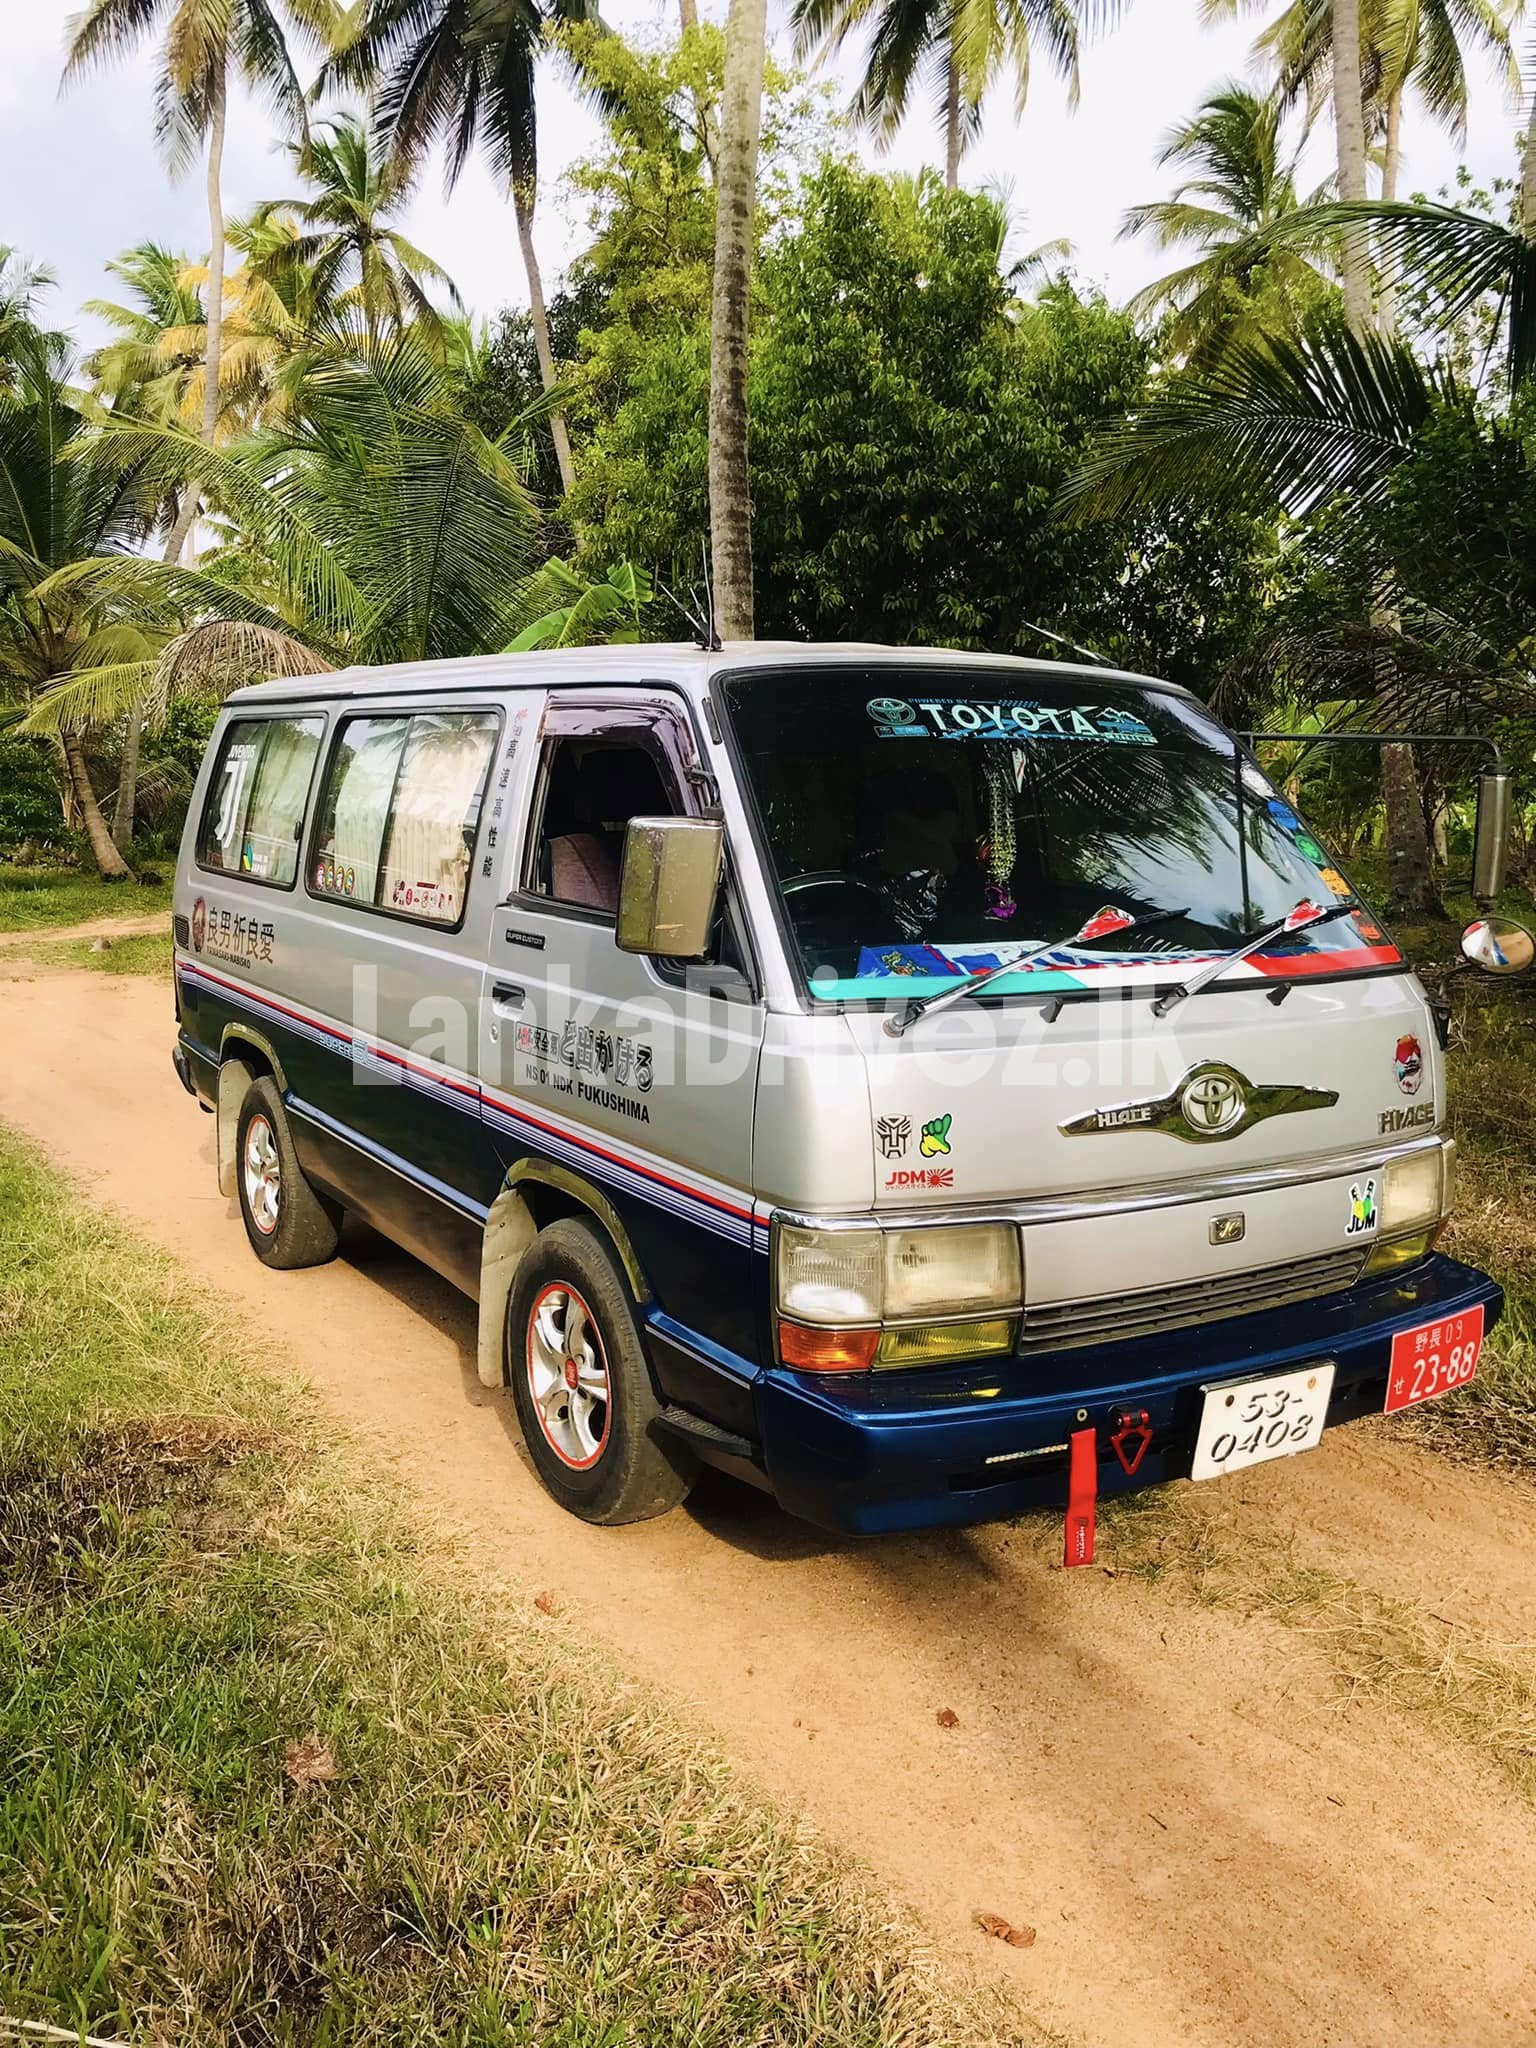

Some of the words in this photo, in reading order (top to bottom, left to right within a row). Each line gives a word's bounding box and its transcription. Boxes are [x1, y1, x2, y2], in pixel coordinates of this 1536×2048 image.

[918, 703, 1099, 736] TOYOTA
[525, 1063, 538, 1081] NS
[539, 1068, 550, 1085] 01
[553, 1073, 573, 1095] NDK
[577, 1082, 650, 1124] FUKUSHIMA
[1098, 1107, 1152, 1128] HIACE
[1377, 1101, 1434, 1135] HIACE
[885, 1170, 926, 1186] JDM
[1346, 1208, 1376, 1234] JDM
[1444, 1320, 1463, 1344] 09
[1393, 1378, 1406, 1396] せ
[1408, 1340, 1476, 1401] 23-88
[1210, 1414, 1314, 1464] 0408
